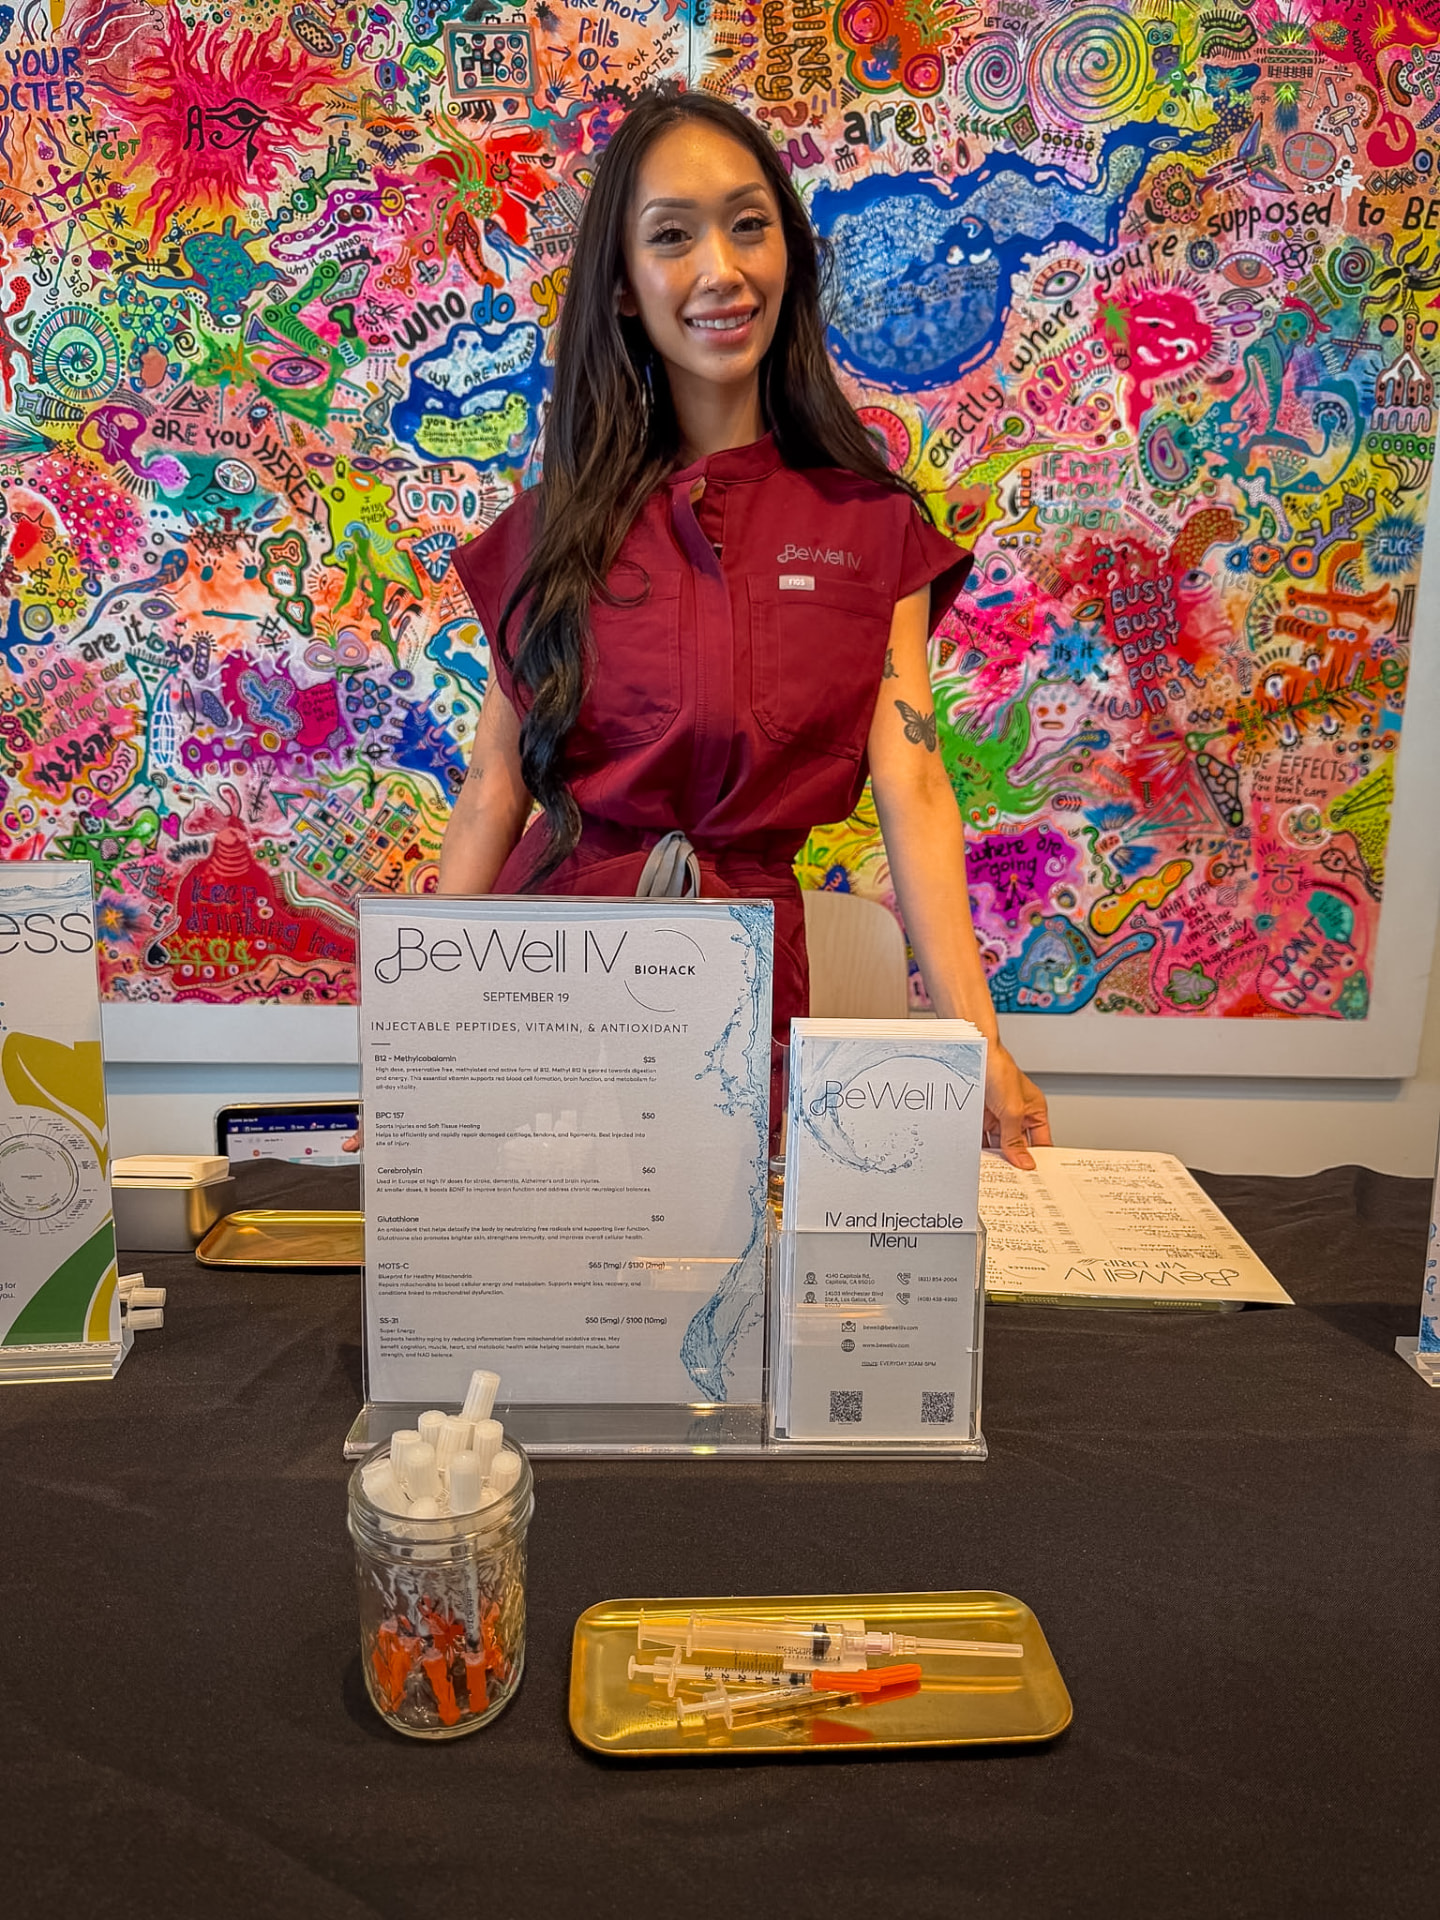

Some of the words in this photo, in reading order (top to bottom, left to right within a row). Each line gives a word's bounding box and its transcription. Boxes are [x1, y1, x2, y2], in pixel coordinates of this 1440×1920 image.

[579, 18, 619, 48] Pills
[984, 17, 1001, 28] LET
[1003, 20, 1021, 31] GO
[5, 47, 84, 77] YOUR
[627, 48, 649, 70] ask
[633, 47, 680, 87] DOCTER
[72, 127, 121, 146] CHAT
[844, 105, 927, 147] are
[101, 139, 141, 161] GPT
[1207, 193, 1334, 238] supposed
[1358, 196, 1385, 227] to
[471, 284, 515, 327] do
[1010, 301, 1079, 374] where
[928, 386, 1004, 469] exactly
[1039, 501, 1120, 533] when
[776, 544, 844, 566] BeWell
[847, 551, 862, 570] IV
[1111, 575, 1174, 615] BUSY
[1113, 599, 1177, 641] BUSY
[1121, 620, 1181, 664] BUSY
[23, 658, 75, 708] you
[79, 633, 121, 662] are
[121, 614, 147, 646] it
[1128, 653, 1173, 690] FOR
[1279, 755, 1349, 782] EFFECTS
[374, 927, 566, 984] BeWell
[584, 930, 628, 974] IV
[634, 965, 696, 976] BIOHACK
[483, 991, 553, 1002] SEPTEMBER
[557, 992, 569, 1003] 19
[371, 1022, 451, 1032] INJECTABLE
[455, 1022, 521, 1034] PEPTIDES,
[526, 1022, 584, 1034] VITAMIN,
[588, 1023, 596, 1033] &
[600, 1023, 689, 1034] ANTIOXIDANT
[394, 1055, 457, 1063] Methylcobalamin
[643, 1056, 656, 1064] $25
[810, 1080, 934, 1116] BeWell
[944, 1082, 975, 1111] IV
[642, 1112, 655, 1120] $50
[377, 1166, 422, 1175] Cerebrolysin
[642, 1166, 656, 1175] $60
[377, 1215, 419, 1223] Glutathione
[651, 1214, 665, 1223] $50
[825, 1211, 842, 1227] IV
[845, 1212, 877, 1228] and
[881, 1213, 964, 1231] Injectable
[870, 1232, 918, 1249] Menu
[378, 1262, 409, 1270] MOTS-C
[588, 1261, 602, 1269] $65
[603, 1261, 622, 1270] (1mg)
[1064, 1267, 1096, 1282] IV
[1103, 1268, 1240, 1287] BeWell
[585, 1316, 599, 1324] $50
[600, 1316, 620, 1325] (5mg)
[626, 1316, 643, 1324] $100
[644, 1316, 667, 1325] (10mg)
